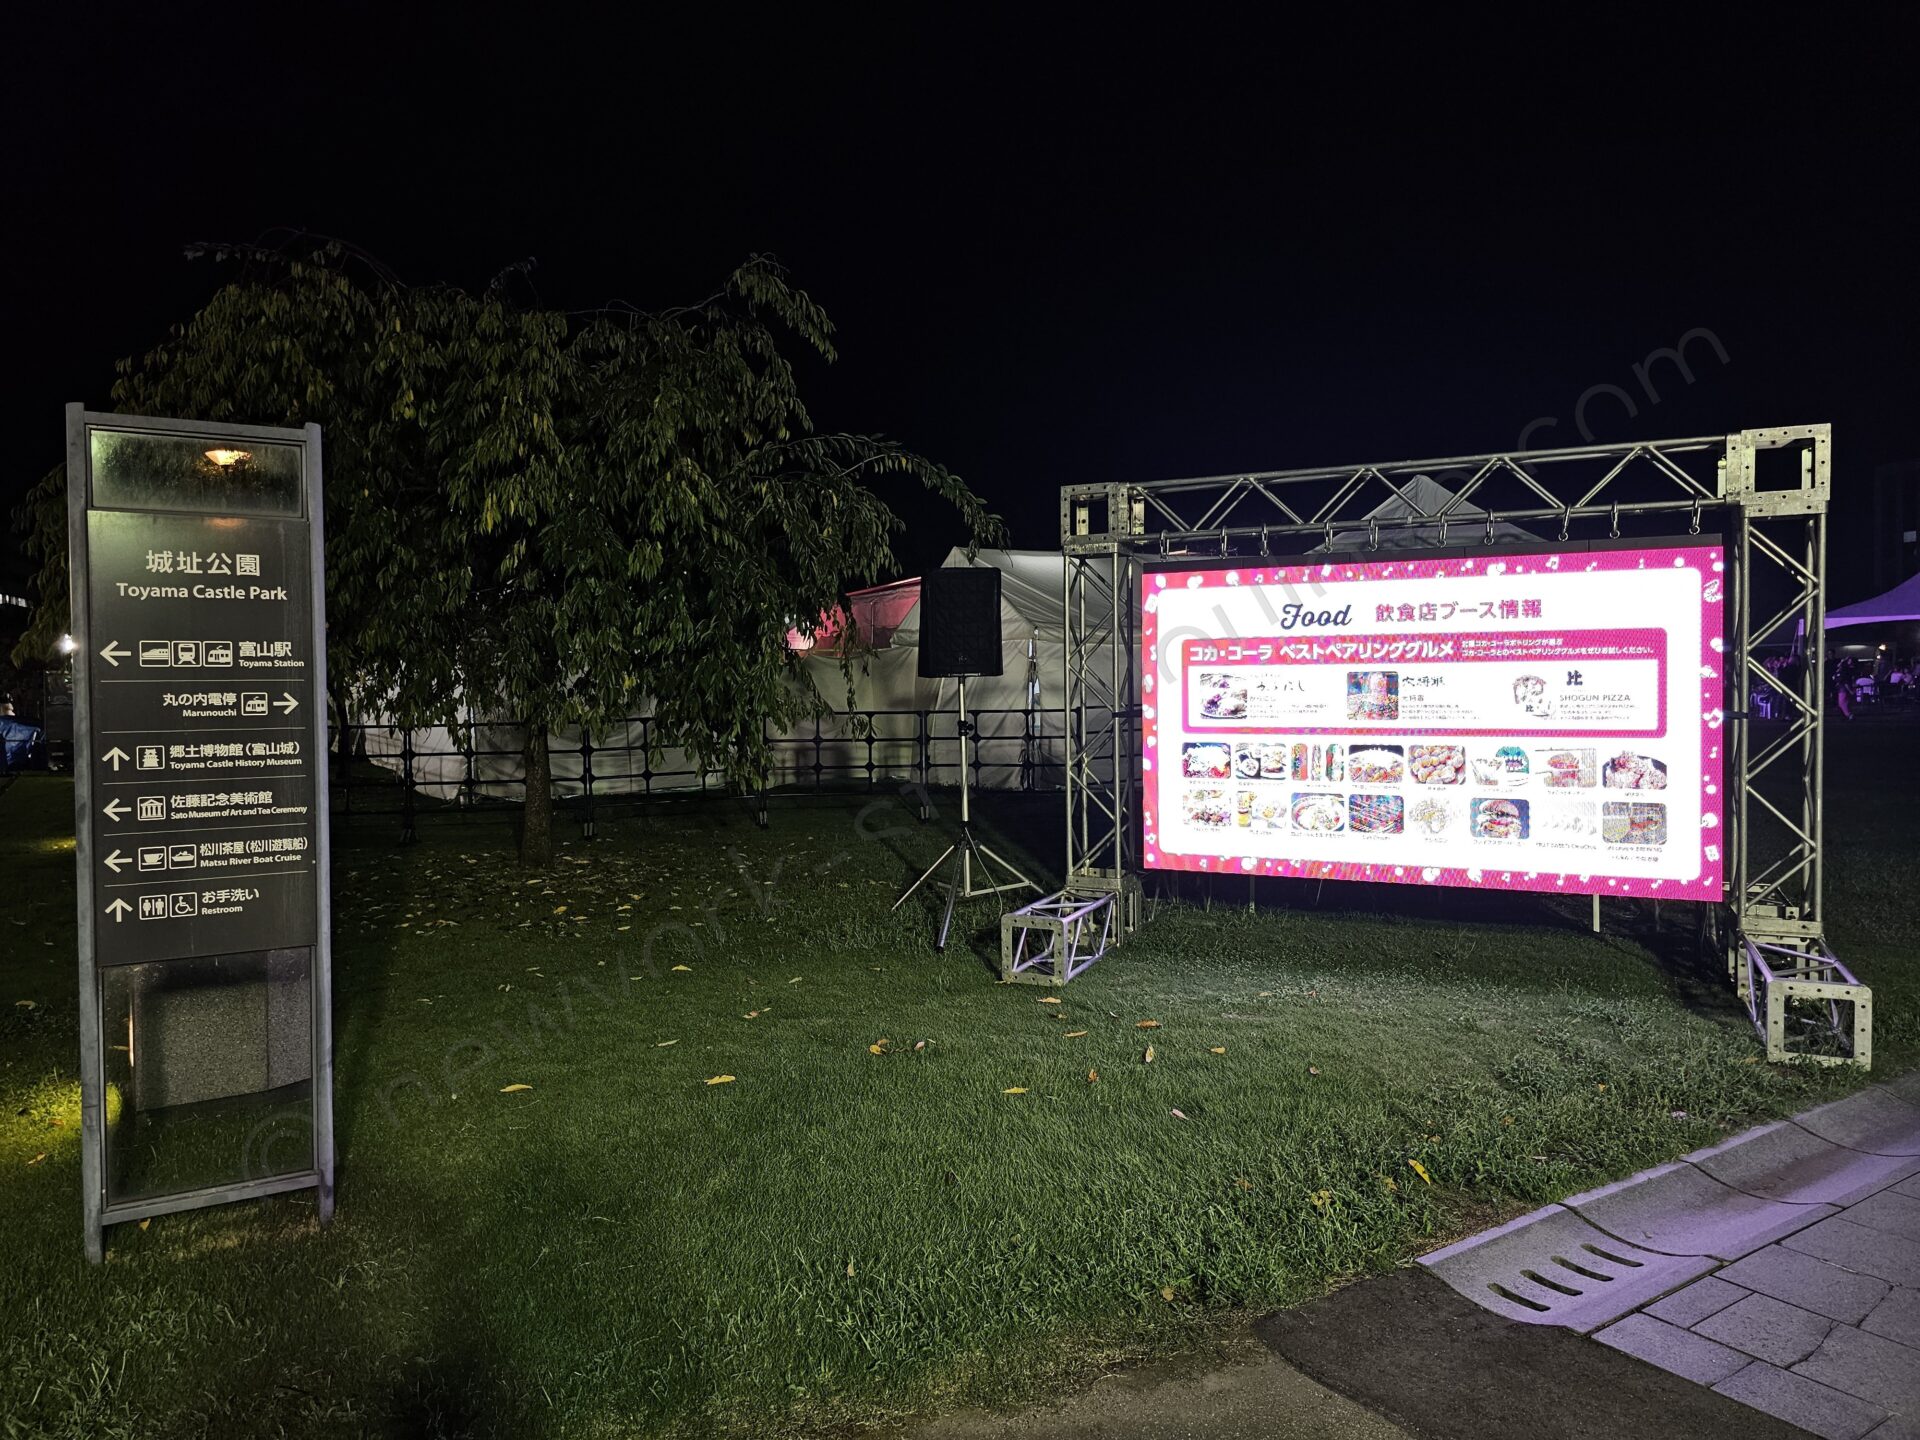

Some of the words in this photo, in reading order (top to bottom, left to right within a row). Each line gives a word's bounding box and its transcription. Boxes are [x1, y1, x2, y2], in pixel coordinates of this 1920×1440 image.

[146, 550, 260, 576] 城址公園
[116, 582, 189, 600] Toyama
[193, 584, 246, 599] Castle
[249, 586, 288, 600] Park
[1281, 603, 1352, 630] Food
[1375, 599, 1542, 622] 飲食店ブース情報
[238, 641, 292, 657] 富山駅
[1189, 645, 1274, 662] コカ・コーラ
[1279, 640, 1455, 660] ベストペアリンググルメ
[238, 660, 272, 669] Toyama
[274, 660, 305, 668] Station
[162, 692, 237, 707] 丸の内電停
[1559, 694, 1600, 702] SHOGUN
[1602, 694, 1631, 702] PIZZA
[182, 708, 237, 718] Marunouchi
[169, 741, 301, 758] 郷土博物館（富山城）
[170, 761, 205, 770] Toyama
[206, 760, 234, 768] Castle
[235, 758, 265, 768] History
[266, 757, 303, 766] Museum
[170, 791, 273, 809] 佐藤記念美術館
[170, 811, 188, 820] Sato
[188, 810, 222, 819] Museum
[224, 809, 230, 817] of
[230, 808, 243, 816] Art
[243, 808, 256, 816] and
[258, 807, 271, 815] Tea
[271, 805, 308, 815] Ceremony
[200, 859, 227, 868] Matsu
[229, 857, 252, 866] River
[253, 855, 273, 864] Boat
[275, 853, 302, 863] Cruise
[201, 888, 260, 904] お手洗い
[201, 905, 243, 915] Restroom
